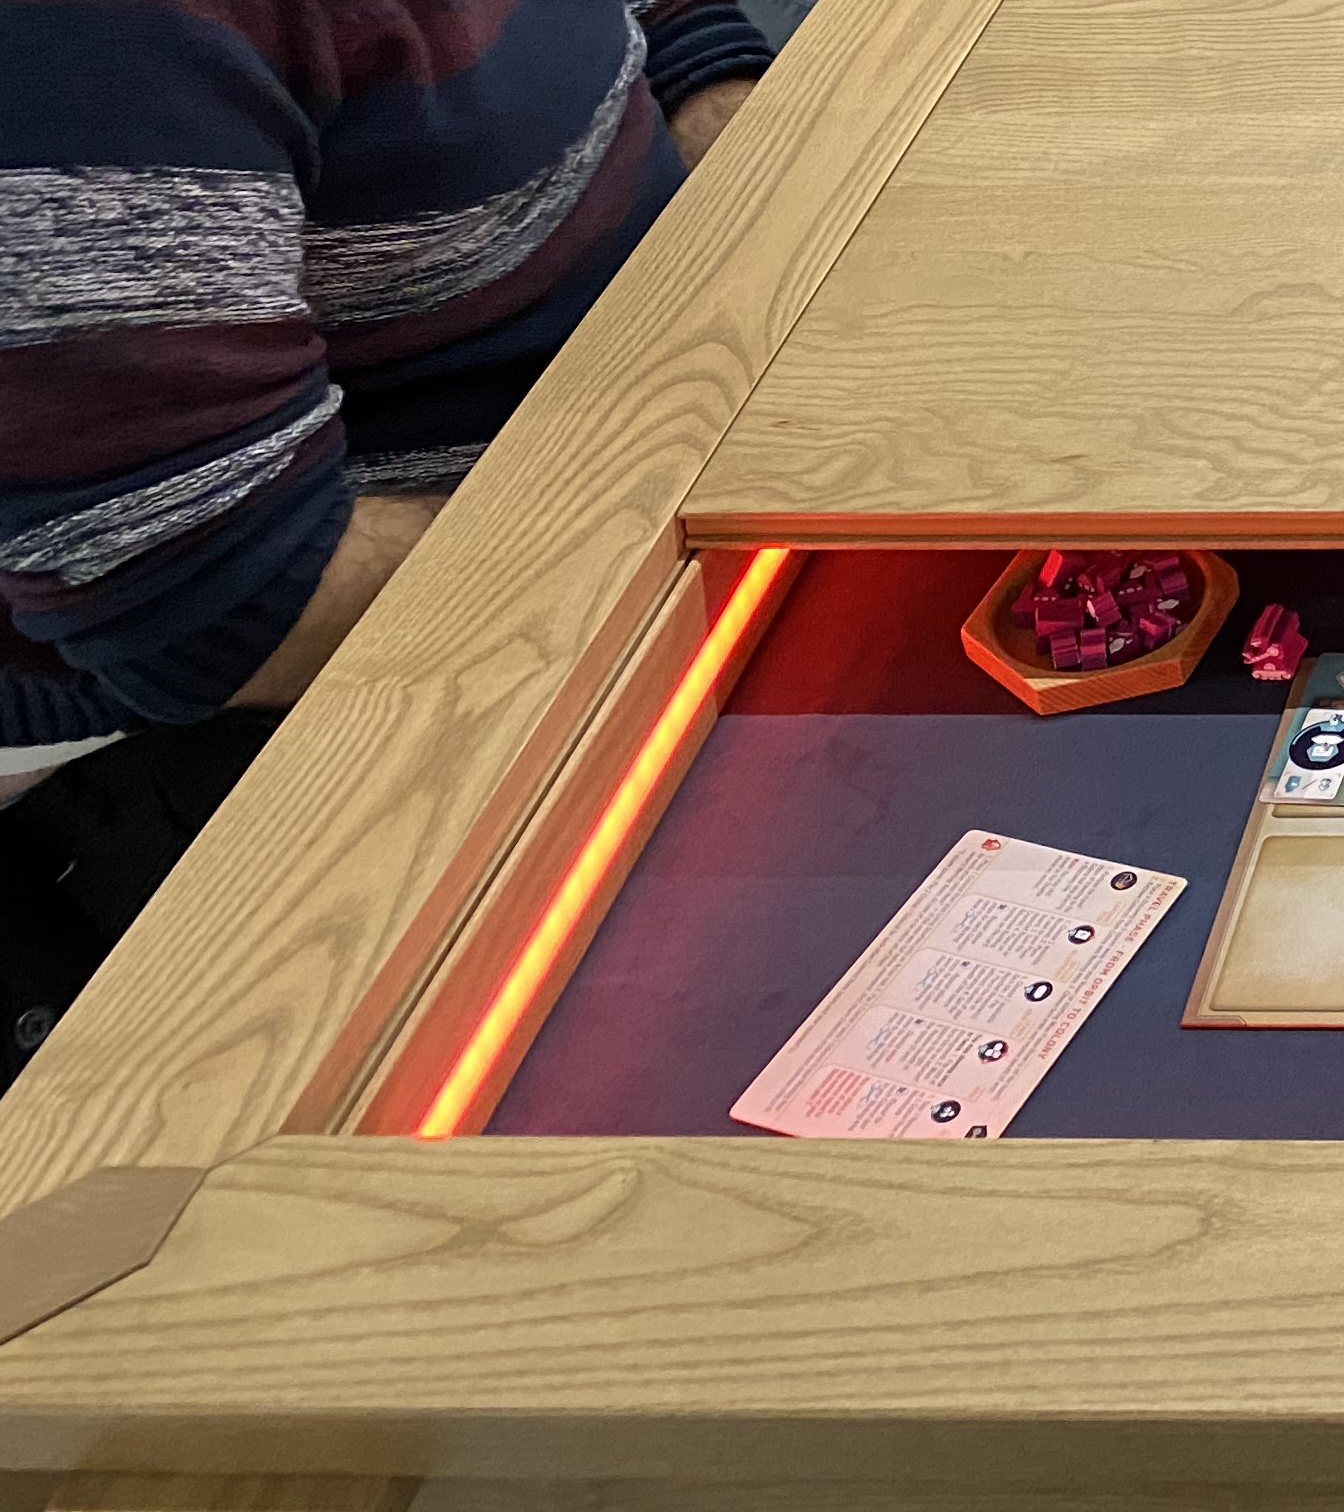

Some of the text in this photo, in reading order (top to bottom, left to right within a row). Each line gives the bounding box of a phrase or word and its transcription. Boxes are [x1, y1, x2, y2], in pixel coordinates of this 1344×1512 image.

[1038, 880, 1178, 1060] TRAVEL PHASE FROM ORBIT TO COLONY
